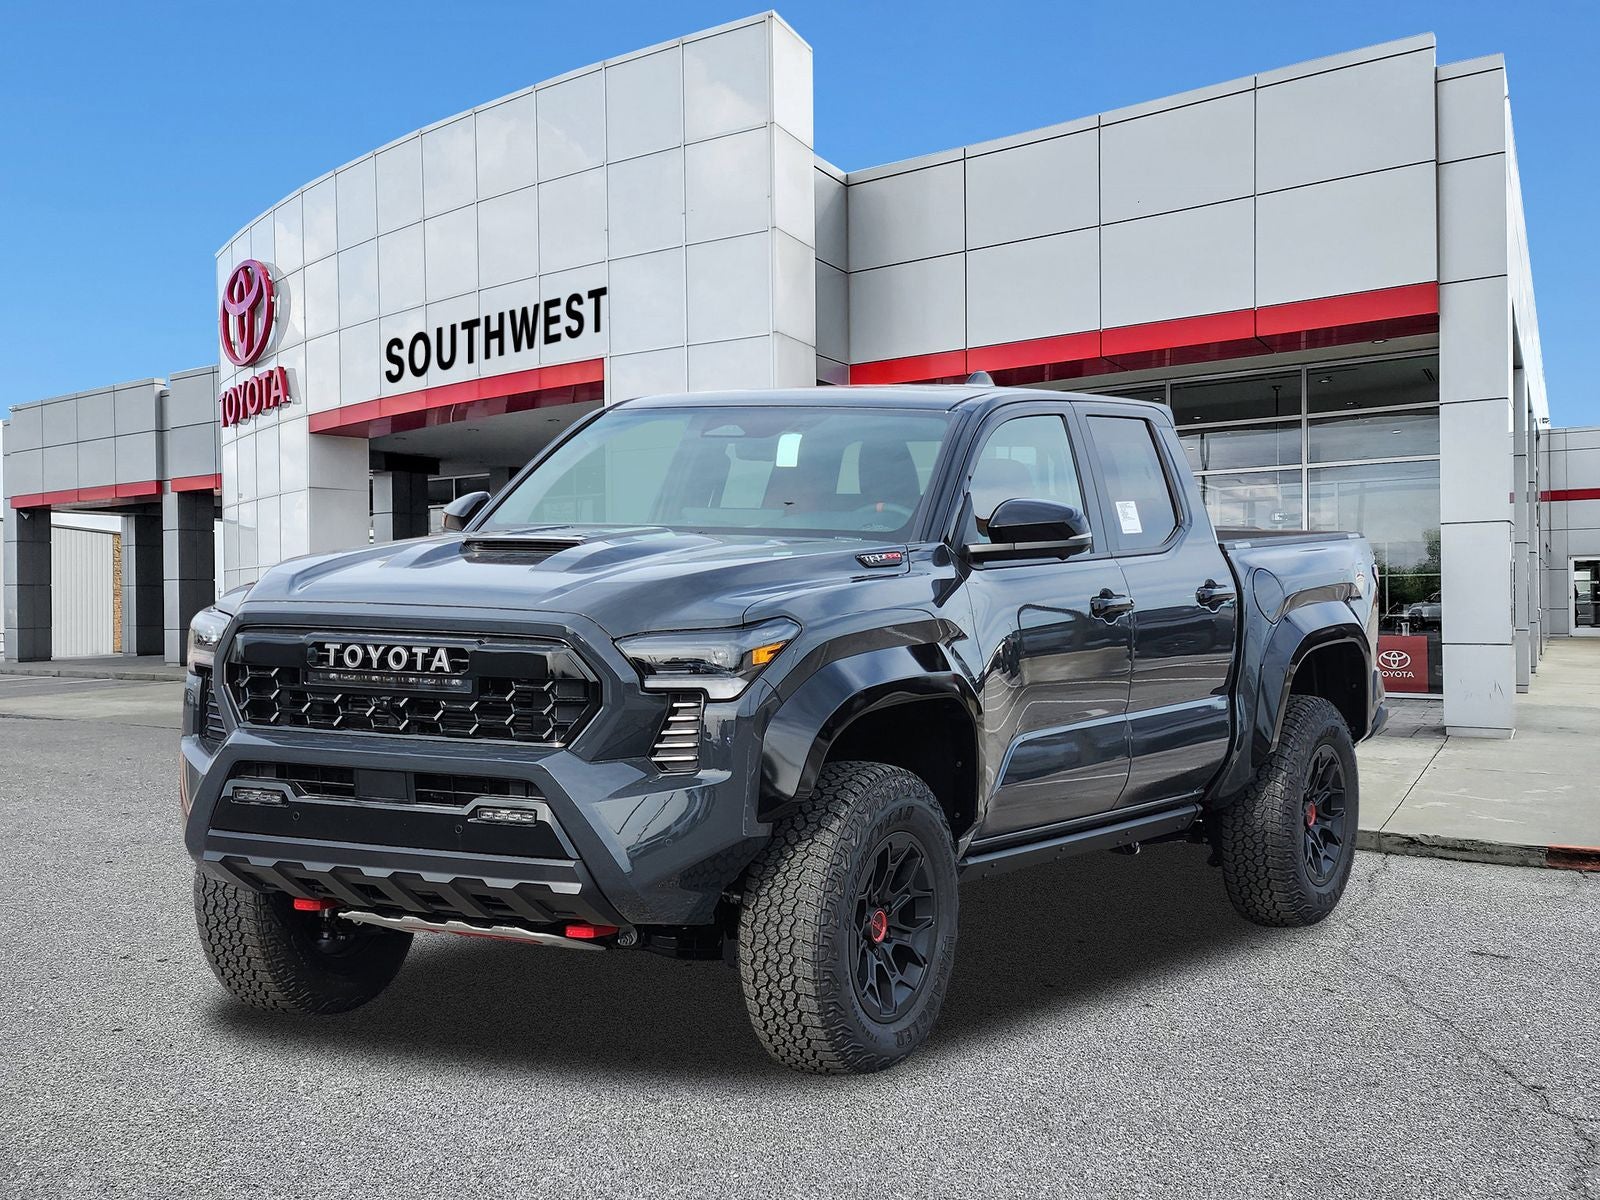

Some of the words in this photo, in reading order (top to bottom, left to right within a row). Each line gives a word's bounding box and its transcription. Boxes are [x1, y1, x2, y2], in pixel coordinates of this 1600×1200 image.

[385, 286, 608, 384] SOUTHWEST
[217, 366, 290, 427] TOYOTA
[324, 643, 451, 673] TOYOTA
[1380, 670, 1415, 678] OYOTA
